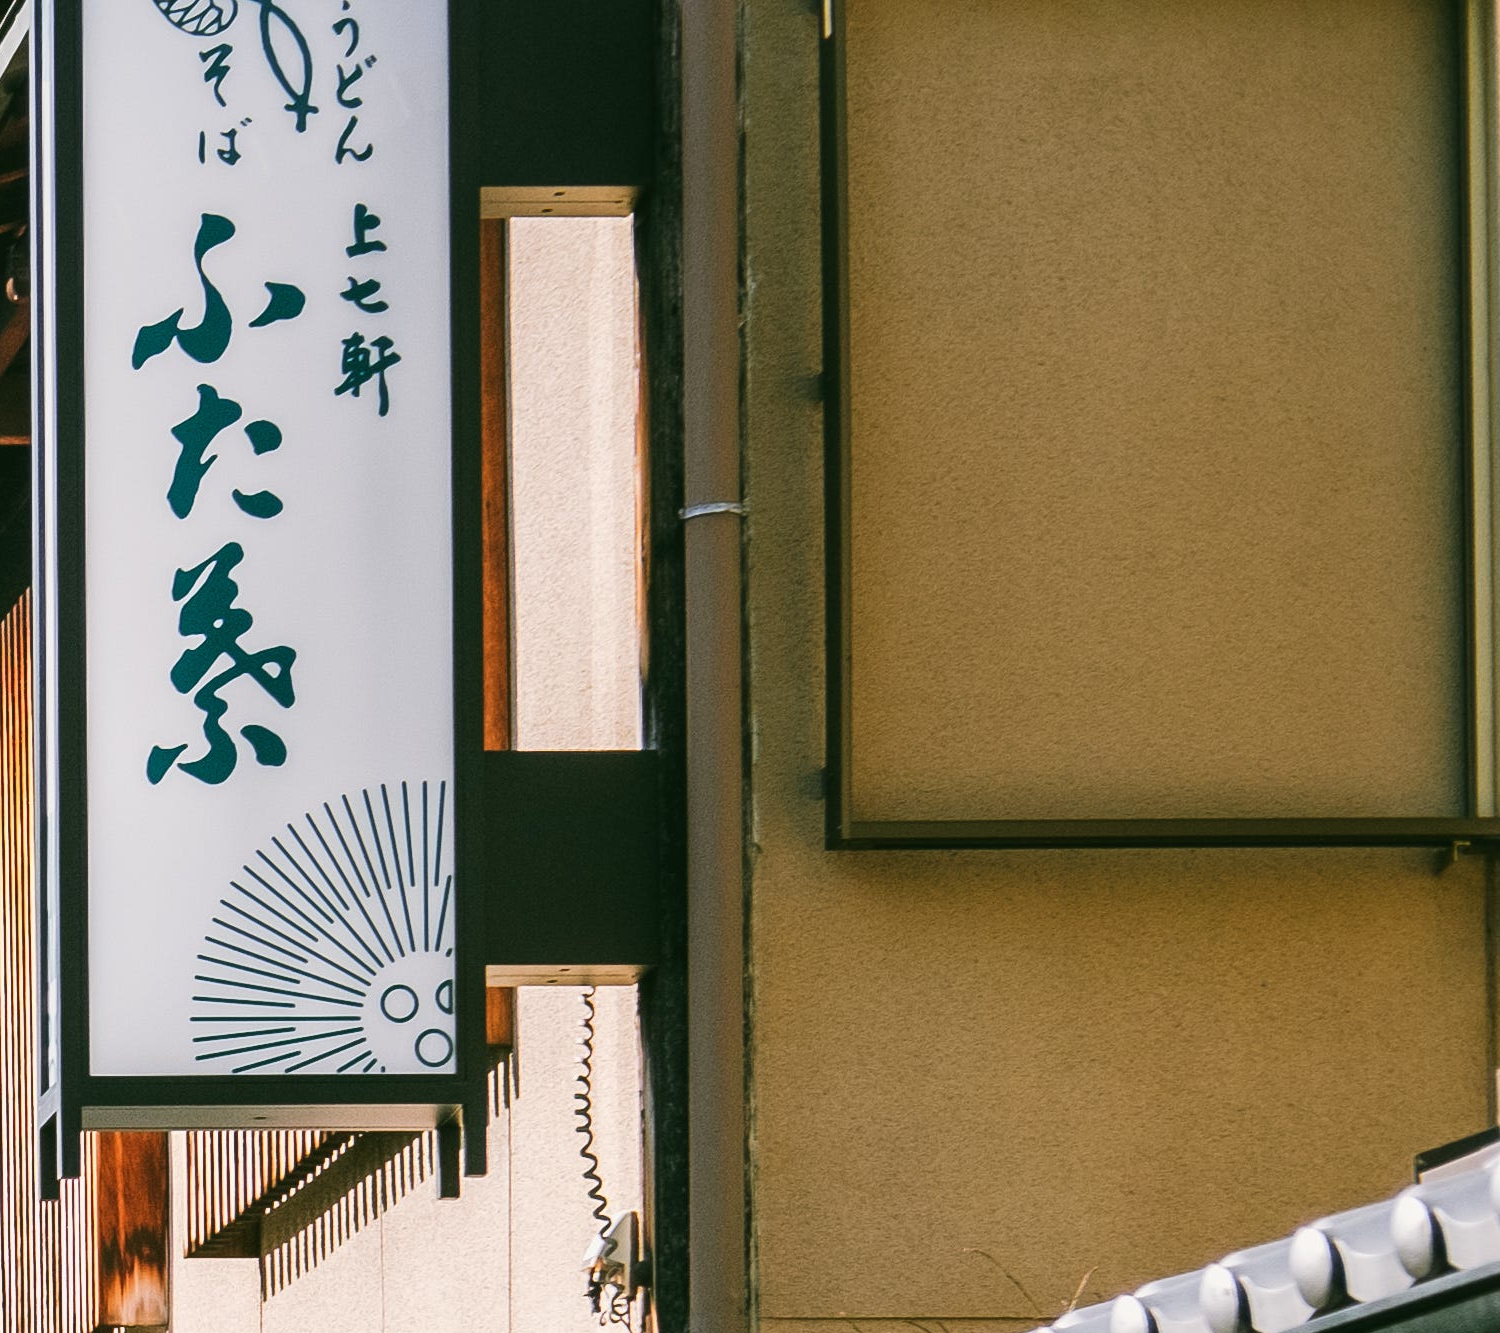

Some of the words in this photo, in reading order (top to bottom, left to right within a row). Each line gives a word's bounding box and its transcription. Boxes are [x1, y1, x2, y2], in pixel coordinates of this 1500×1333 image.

[198, 43, 253, 166] そば
[332, 0, 377, 165] うどん
[334, 202, 402, 418] 上七軒
